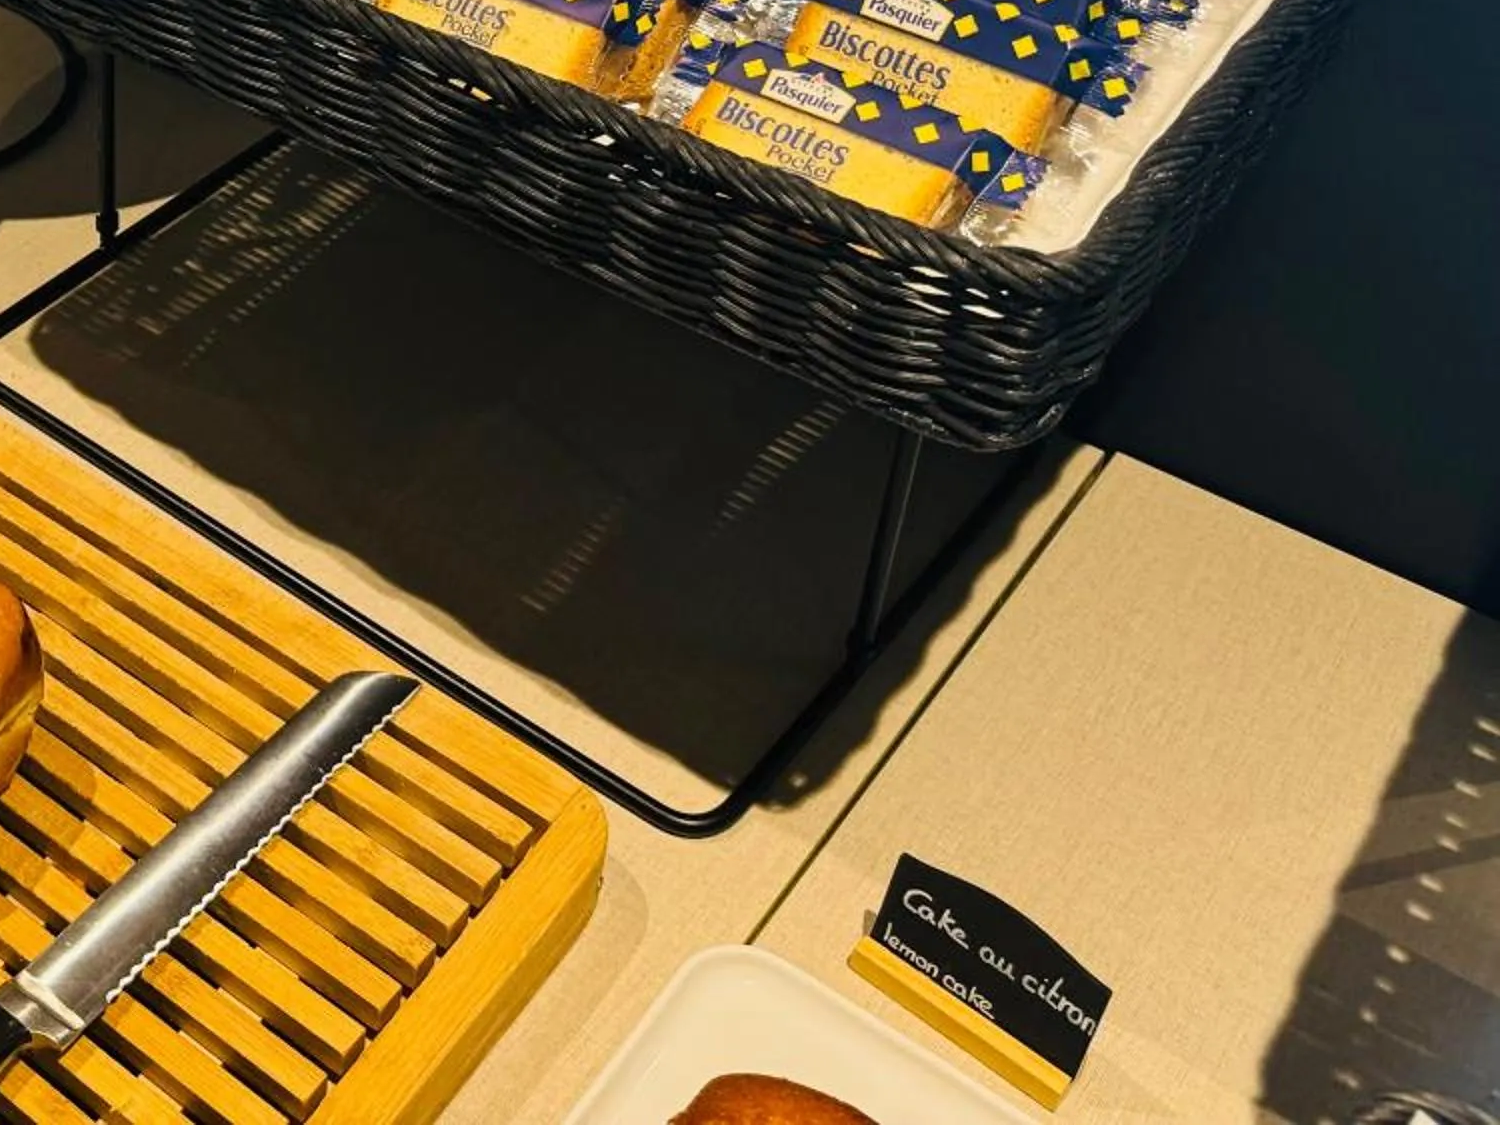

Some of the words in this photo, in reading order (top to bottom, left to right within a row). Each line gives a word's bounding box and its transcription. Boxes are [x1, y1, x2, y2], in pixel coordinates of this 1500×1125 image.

[441, 13, 498, 48] Pocket
[819, 20, 950, 90] Biscottes
[770, 76, 845, 115] Pasquier
[871, 70, 940, 104] Pocket
[716, 96, 849, 167] Biscottes
[766, 144, 837, 183] Pocket
[884, 922, 939, 978] lemon
[942, 973, 995, 1020] cake
[902, 888, 970, 950] Cake
[979, 946, 1015, 980] au
[1021, 977, 1098, 1036] citron
